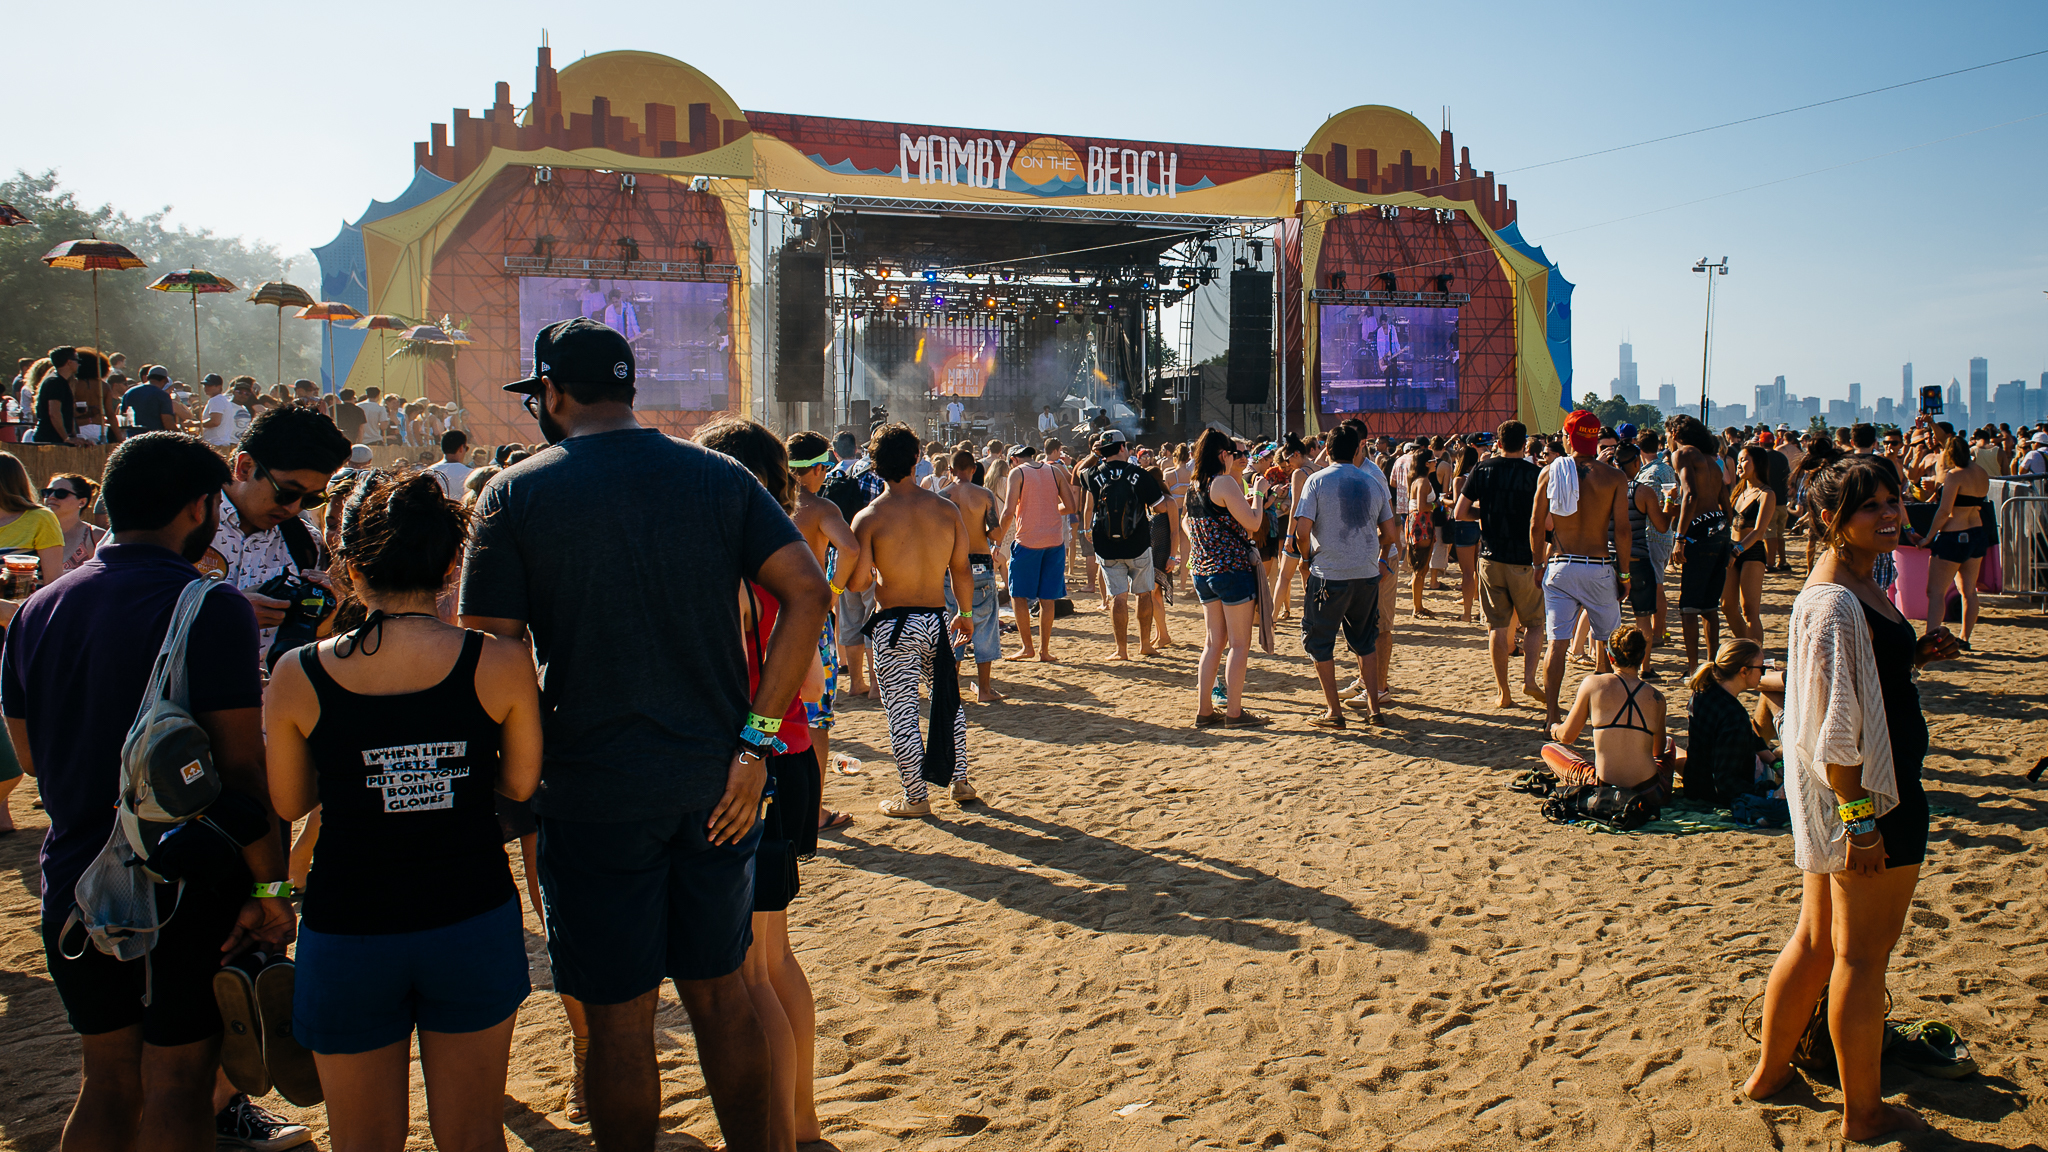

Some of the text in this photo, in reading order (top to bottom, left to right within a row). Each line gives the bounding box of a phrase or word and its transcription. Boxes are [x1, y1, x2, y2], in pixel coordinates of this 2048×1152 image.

[900, 132, 1178, 199] MAMBY ON THE BEACH
[948, 368, 980, 386] MAMBY
[369, 746, 455, 761] WHEN LIFE
[391, 759, 430, 771] GETS
[368, 767, 468, 786] PUT ON YOUR
[387, 782, 445, 797] BOXING
[388, 794, 445, 810] GLOVES
